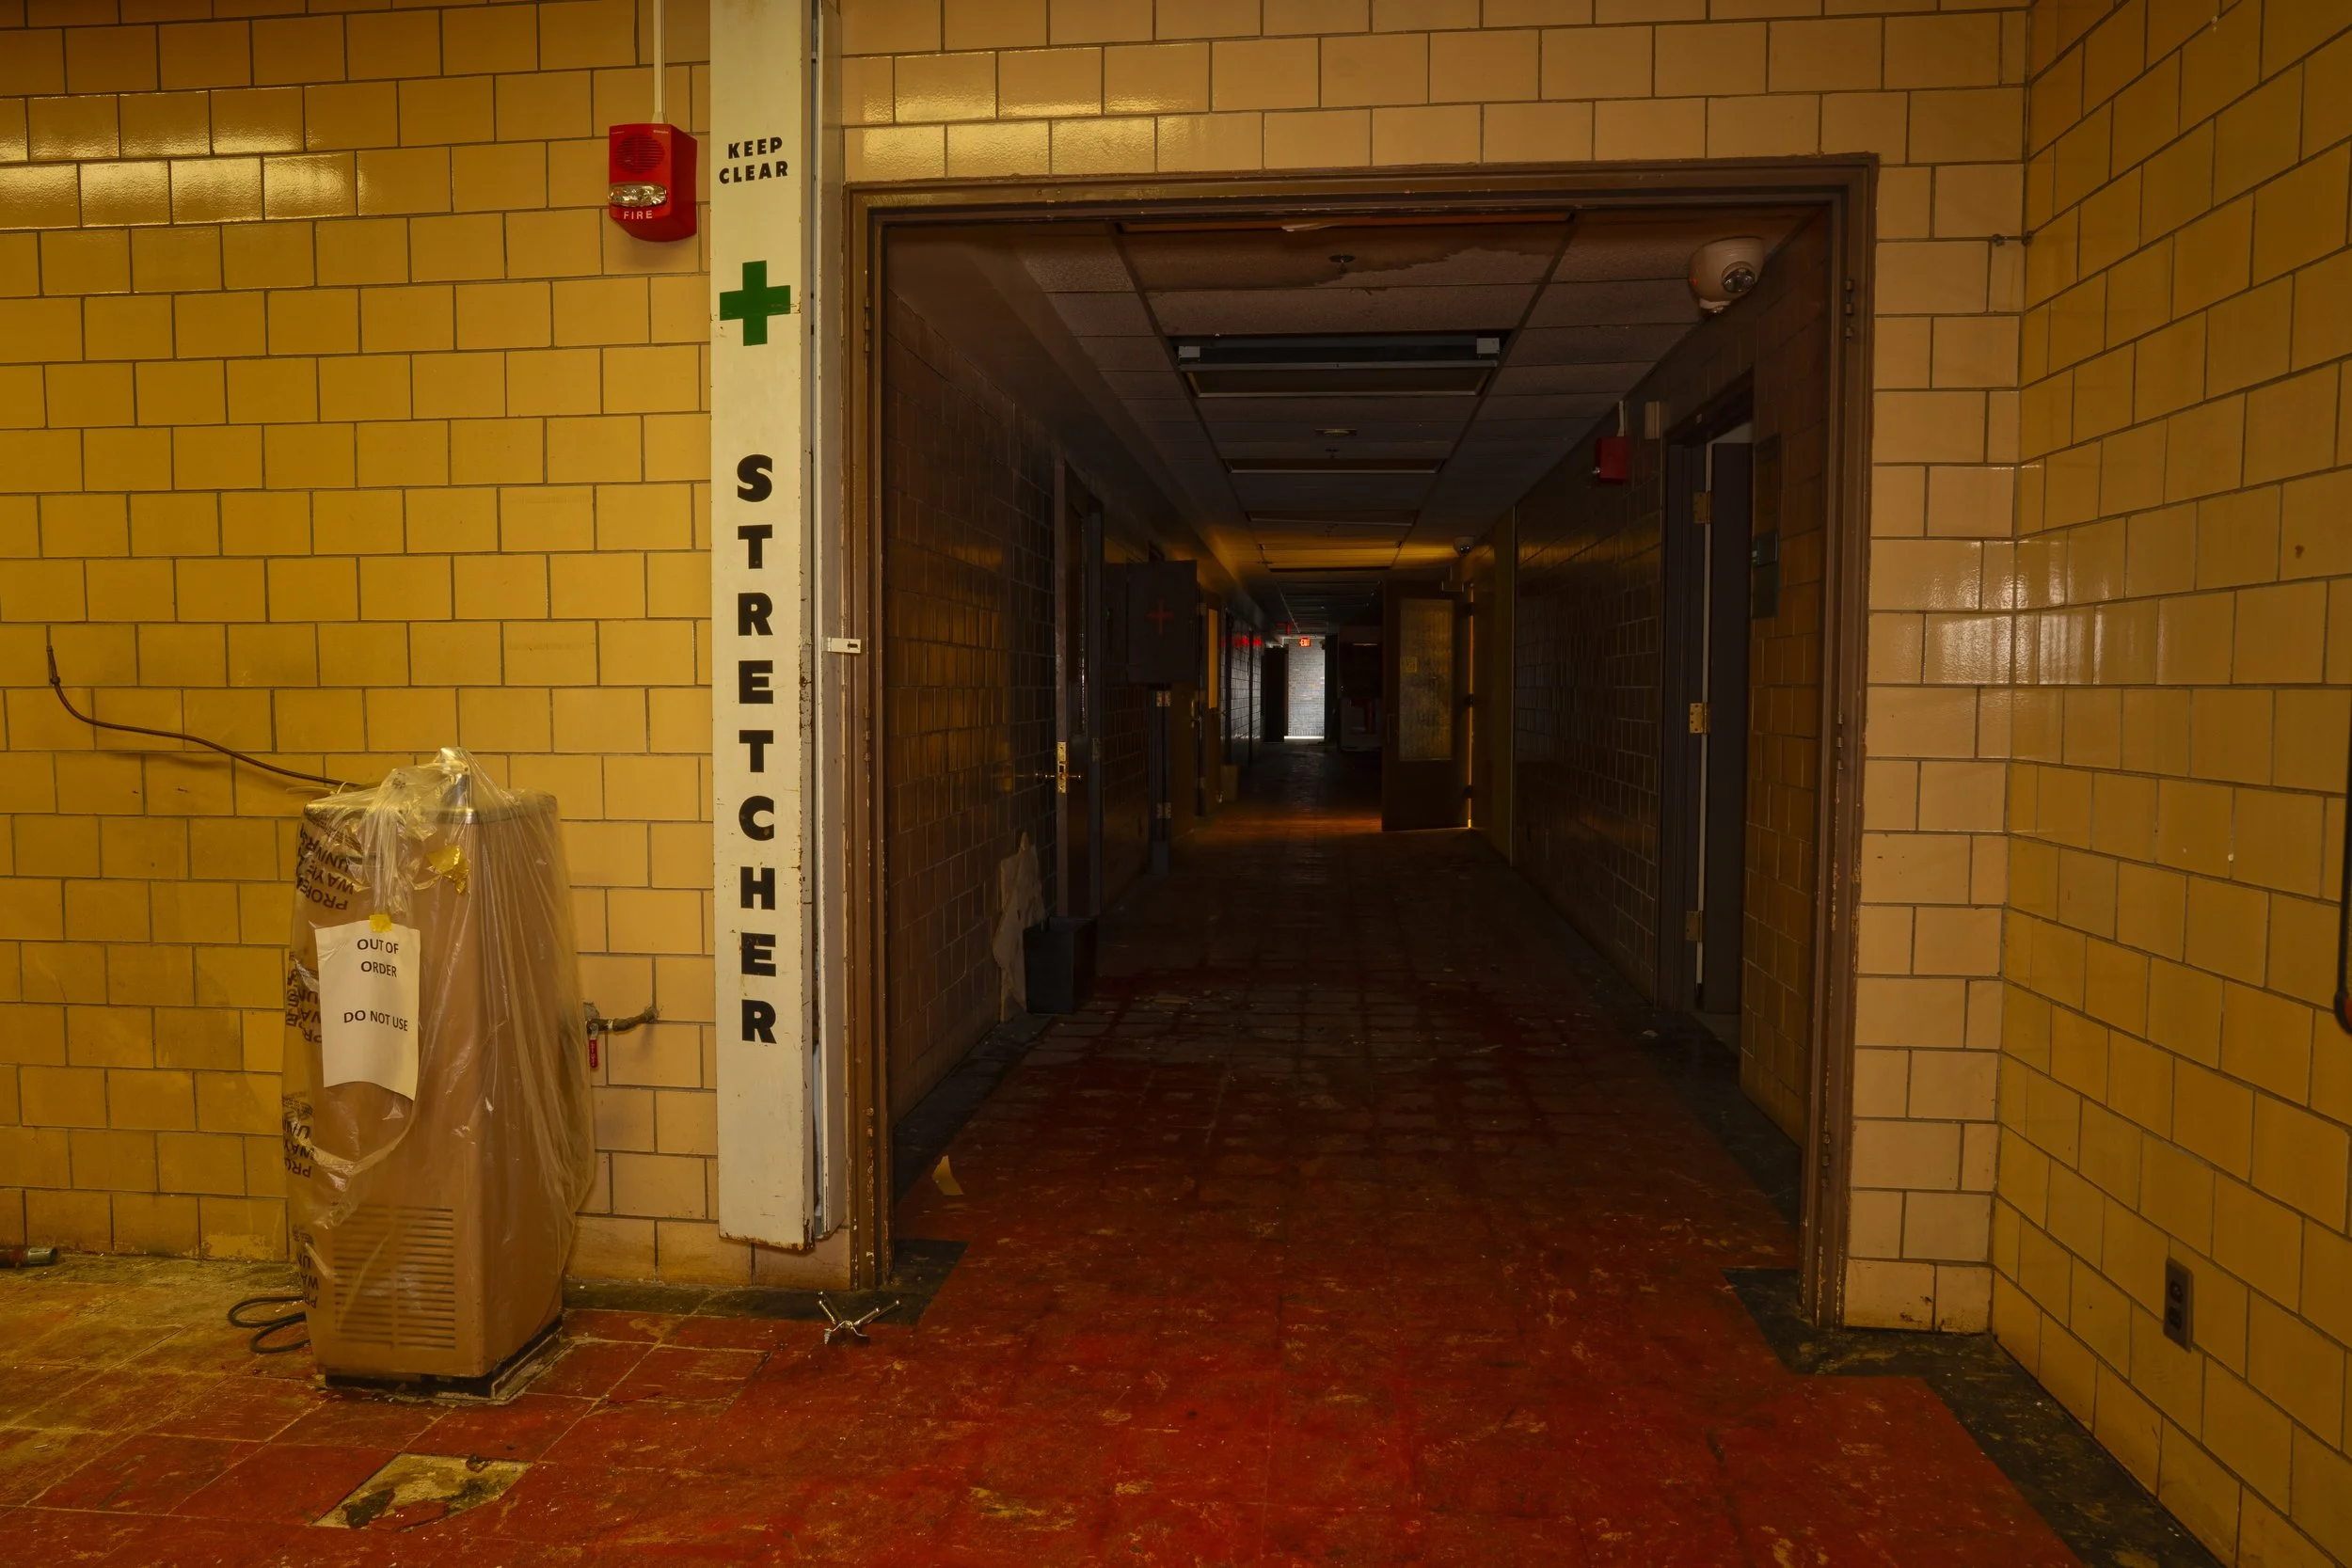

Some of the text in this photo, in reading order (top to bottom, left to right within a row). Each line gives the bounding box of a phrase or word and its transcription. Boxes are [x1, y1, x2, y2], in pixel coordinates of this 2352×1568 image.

[728, 136, 783, 160] KEEP
[719, 161, 788, 184] CLEAR
[623, 210, 653, 220] FIRE
[737, 453, 777, 1044] STRETCHER
[357, 939, 399, 955] OUT OF
[360, 960, 397, 977] ORDER
[343, 1009, 408, 1032] DO NOT USE
